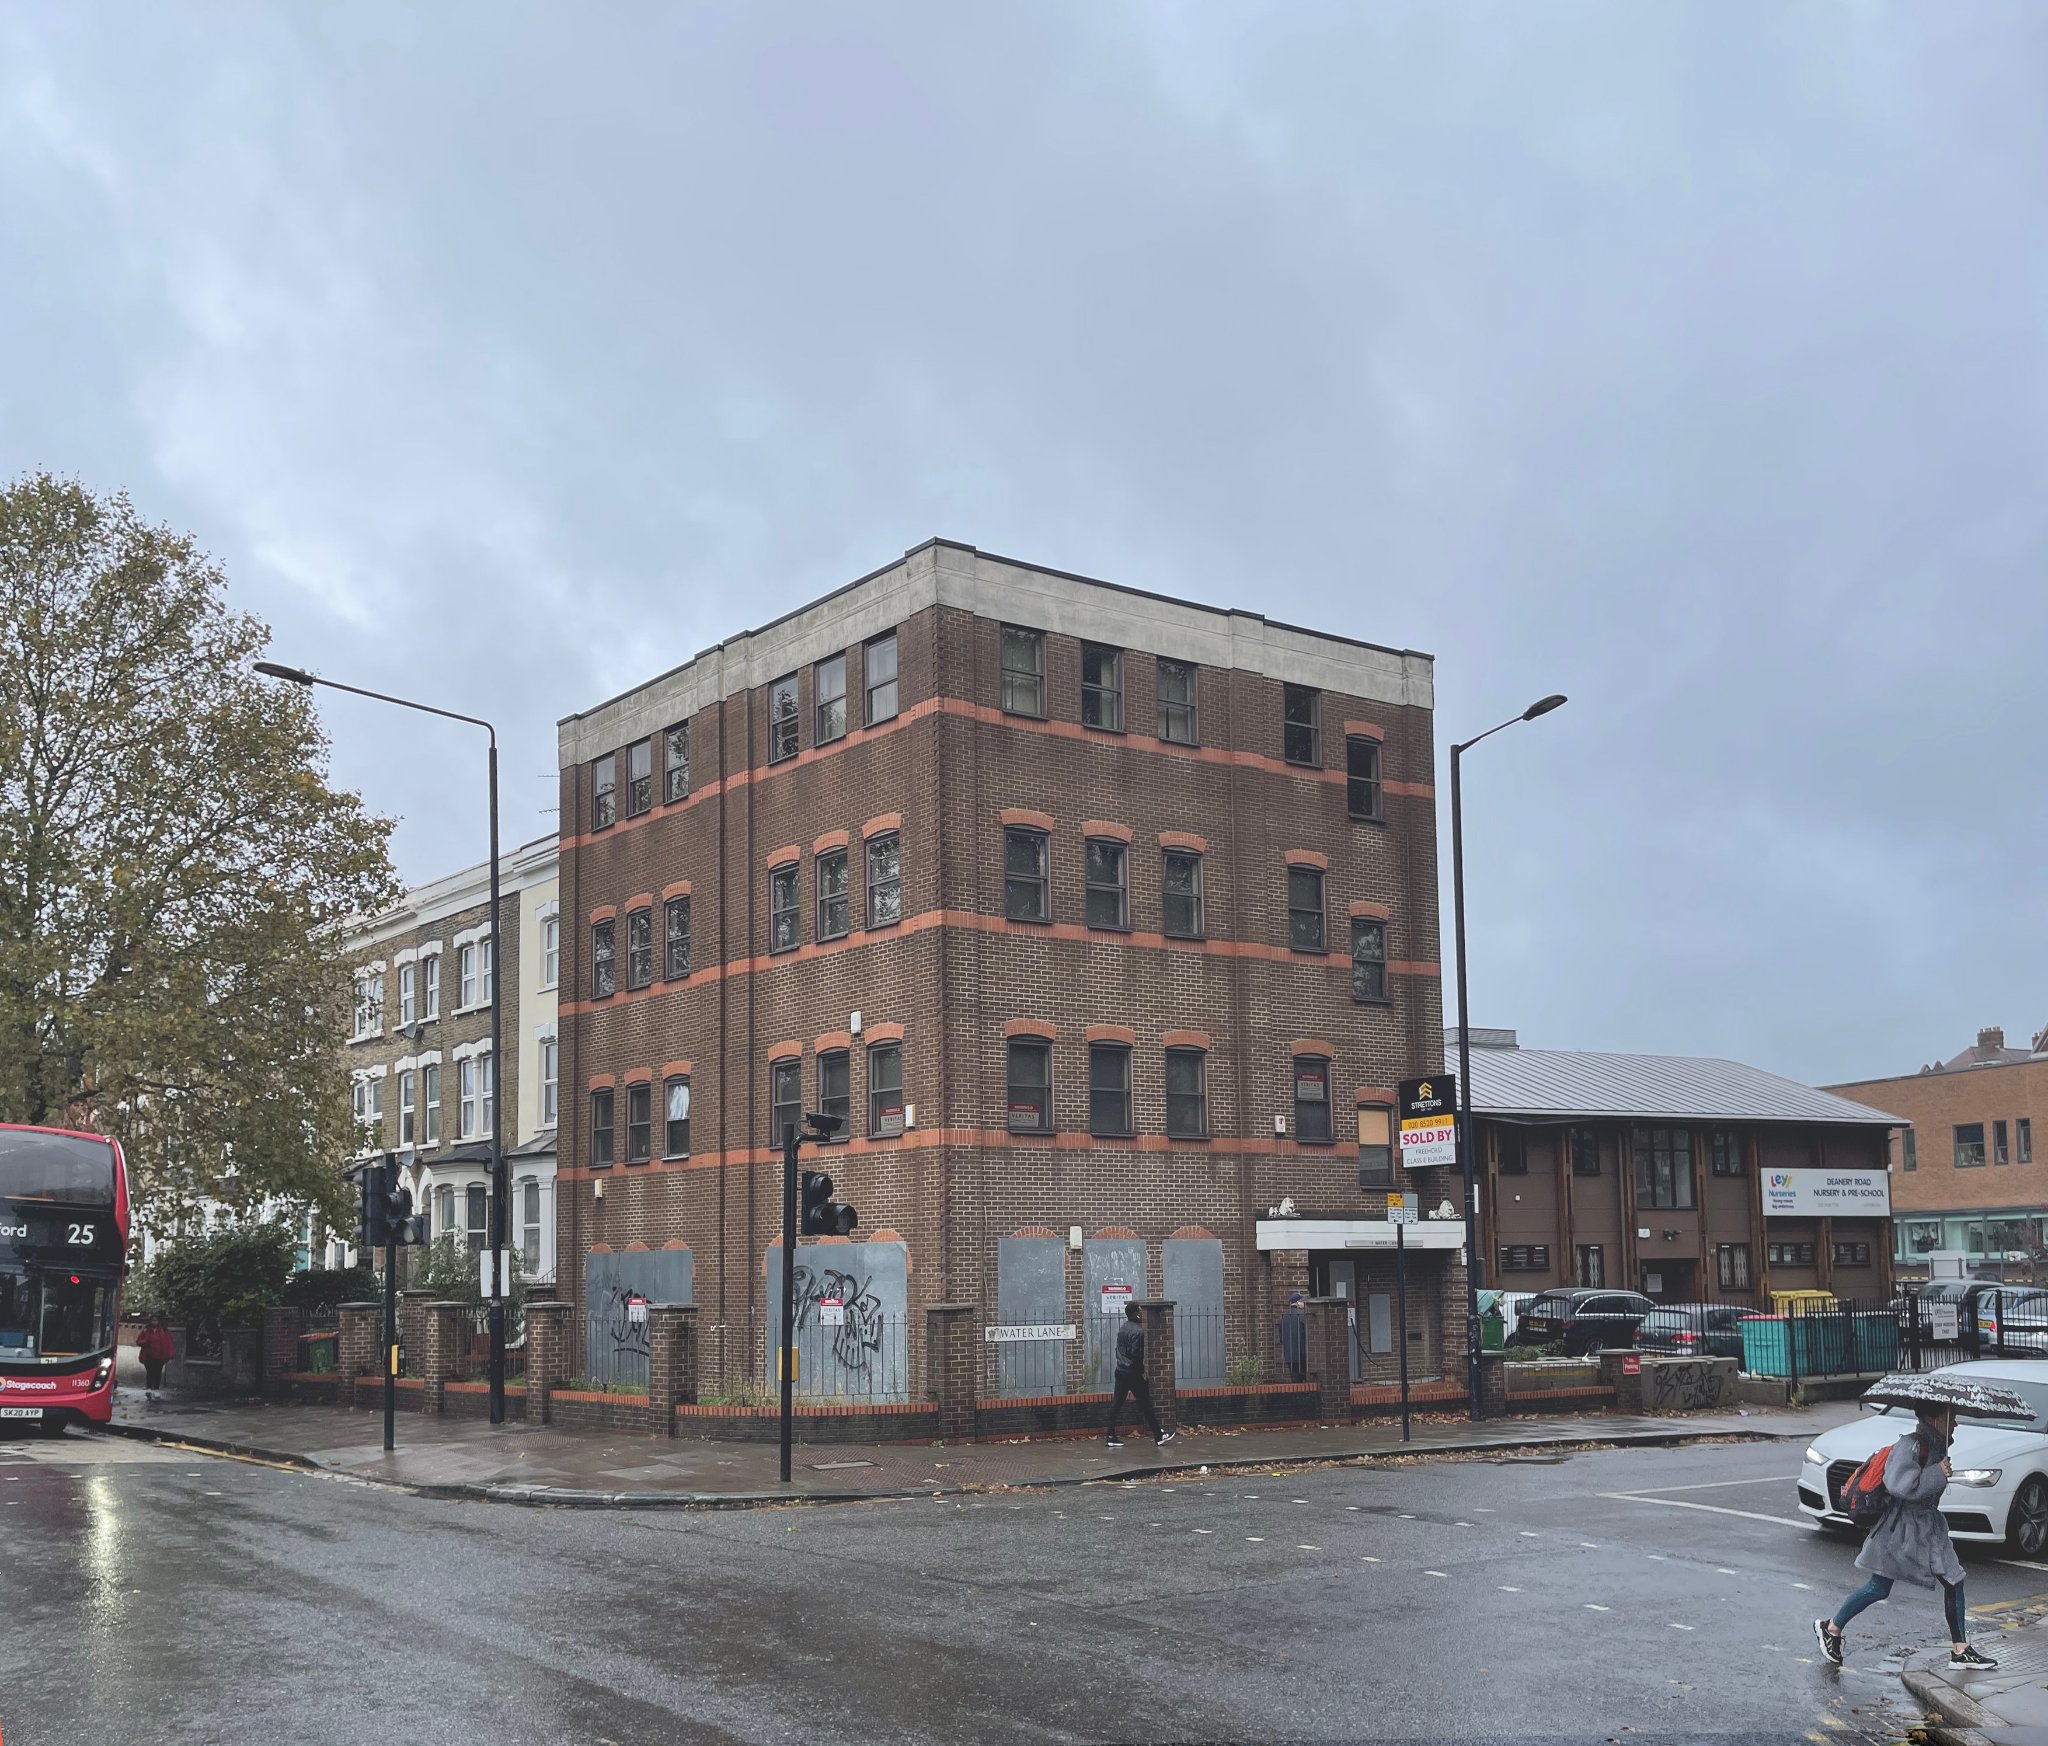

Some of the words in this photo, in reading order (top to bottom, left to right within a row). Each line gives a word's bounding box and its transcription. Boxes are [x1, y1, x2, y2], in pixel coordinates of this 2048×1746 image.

[1411, 1099, 1442, 1110] STRETTONS
[1403, 1131, 1434, 1145] SOLD
[1438, 1129, 1452, 1142] BY
[1415, 1147, 1443, 1155] FREEHOLD
[1407, 1157, 1422, 1165] CLASS
[1428, 1155, 1454, 1163] BUILDING
[1826, 1178, 1853, 1186] DEANERY
[1855, 1178, 1872, 1186] ROAD
[1768, 1189, 1797, 1198] Nurseries
[1813, 1189, 1840, 1197] NURSERY
[1842, 1189, 1847, 1197] &
[1848, 1189, 1885, 1197] PRE-SCHOOL
[67, 1223, 95, 1245] 25
[1000, 1328, 1035, 1338] WATER
[1037, 1327, 1062, 1338] LANE
[6, 1380, 57, 1391] Stagecoach
[72, 1379, 90, 1387] 11360
[3, 1409, 24, 1417] SK20
